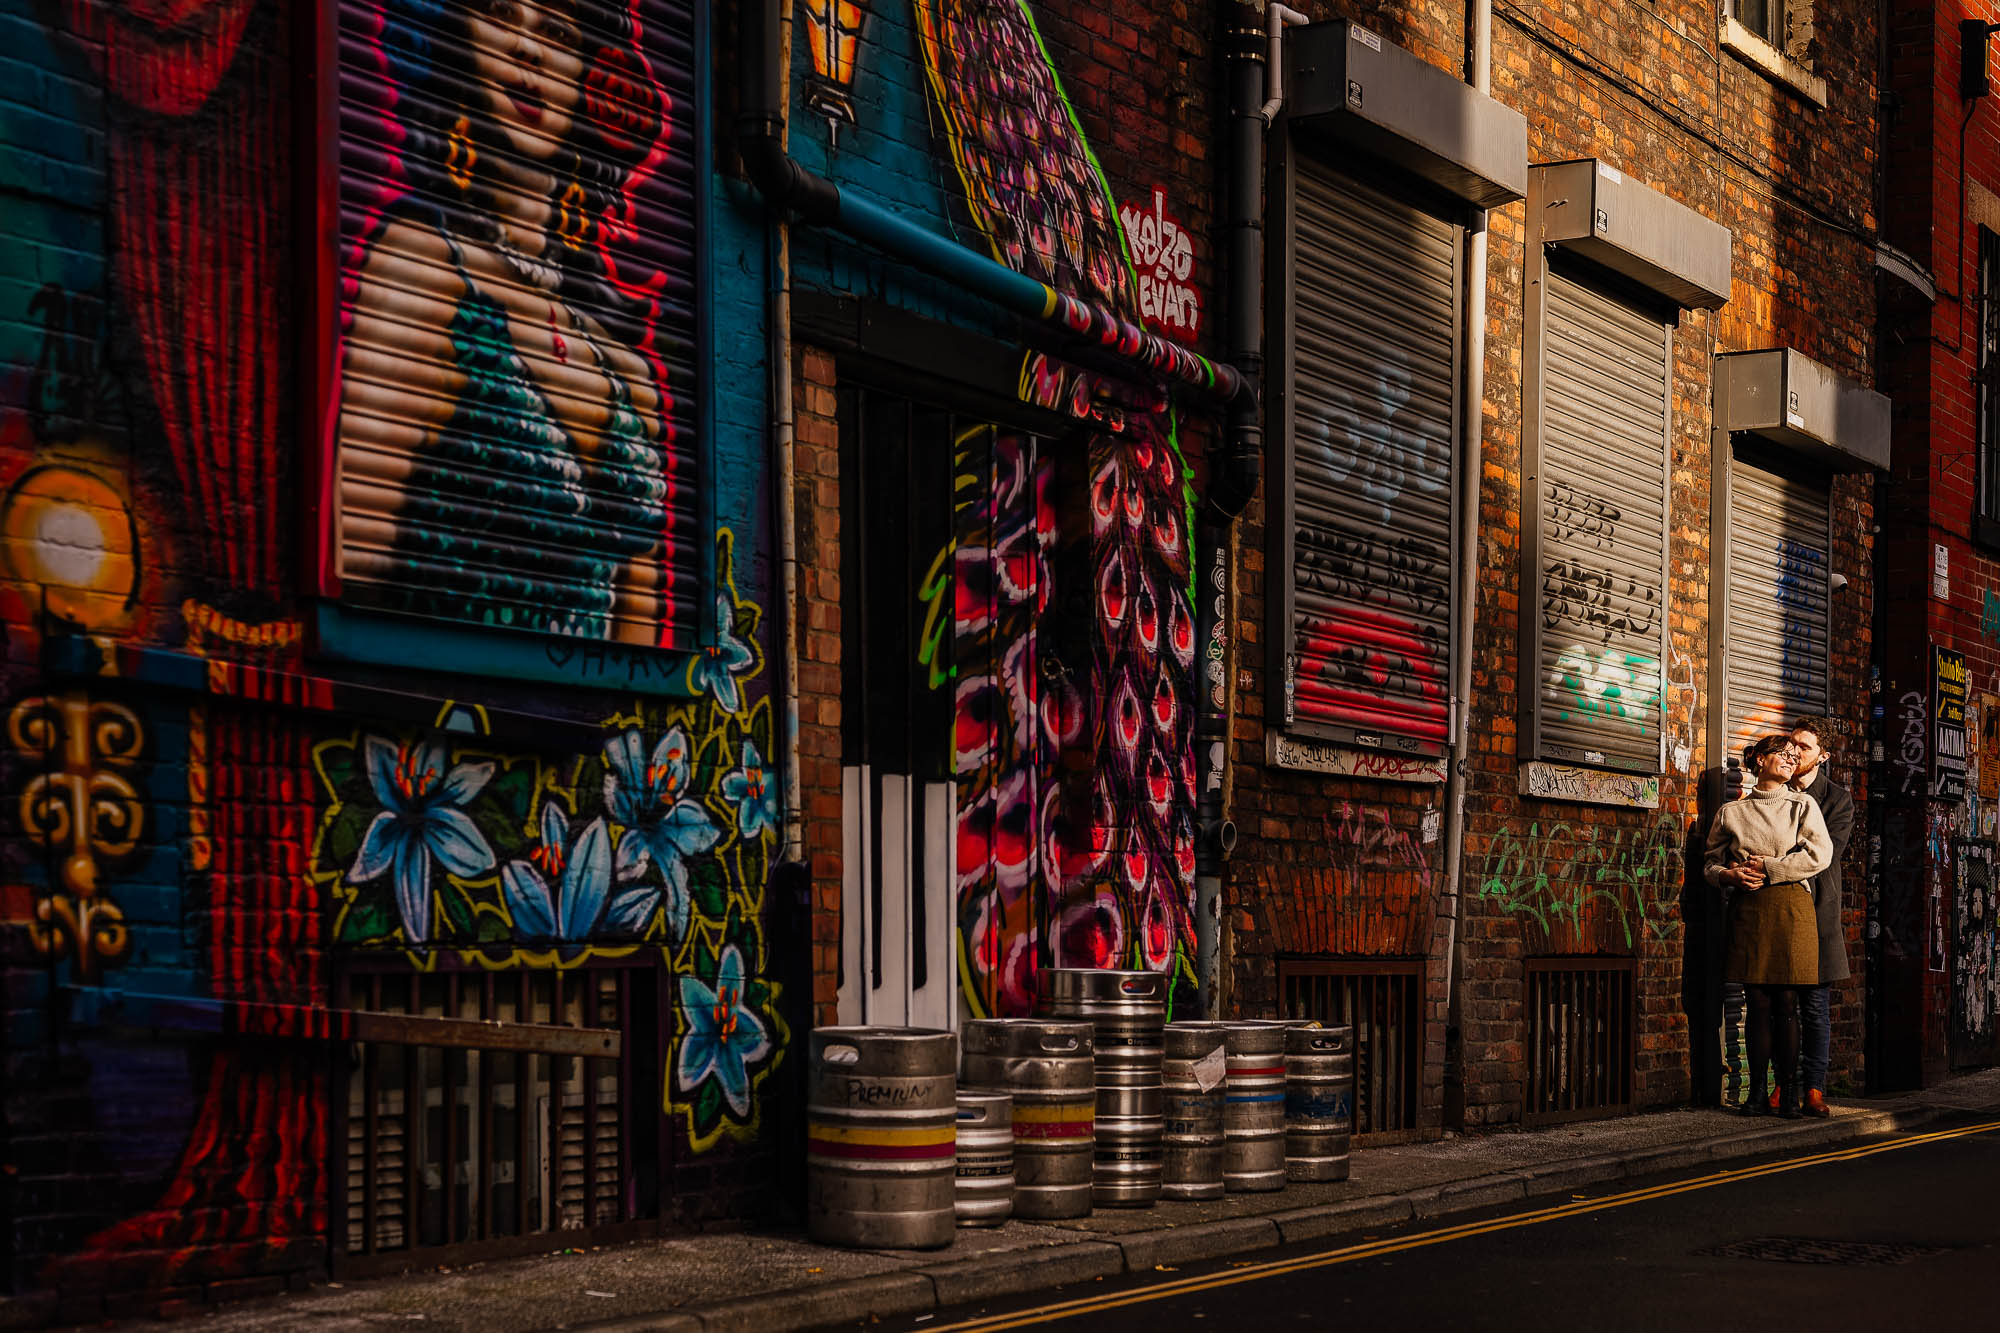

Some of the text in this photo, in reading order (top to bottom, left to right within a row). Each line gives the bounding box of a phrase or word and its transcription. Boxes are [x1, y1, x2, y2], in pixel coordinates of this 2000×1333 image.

[1938, 654, 1955, 681] Studio
[1938, 727, 1966, 758] AATMA
[847, 1079, 936, 1107] PREMIUM
